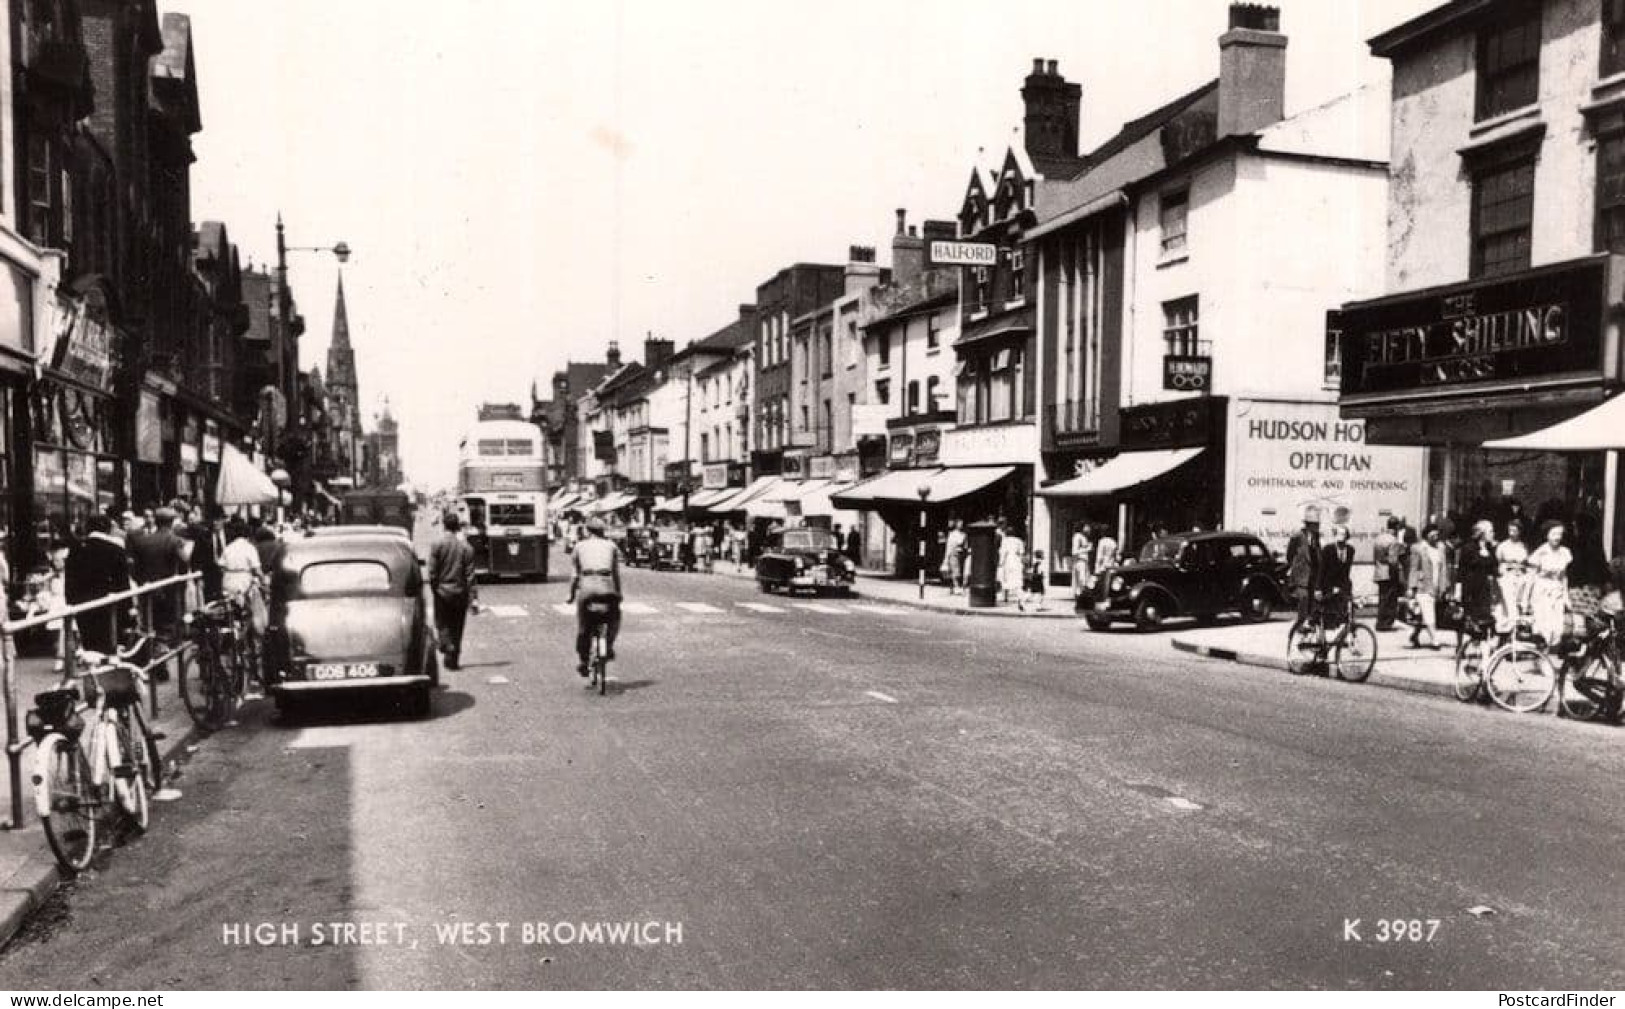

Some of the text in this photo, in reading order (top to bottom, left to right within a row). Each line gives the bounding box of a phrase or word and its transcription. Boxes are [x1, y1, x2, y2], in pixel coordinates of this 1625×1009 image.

[934, 245, 993, 260] HALFORD
[1368, 304, 1562, 363] FIFTY SHILLING
[1248, 420, 1365, 442] HUDSON HO
[1289, 451, 1372, 471] OPTICIAN
[1247, 477, 1407, 492] OPHTHALMIC AND DISPENSING
